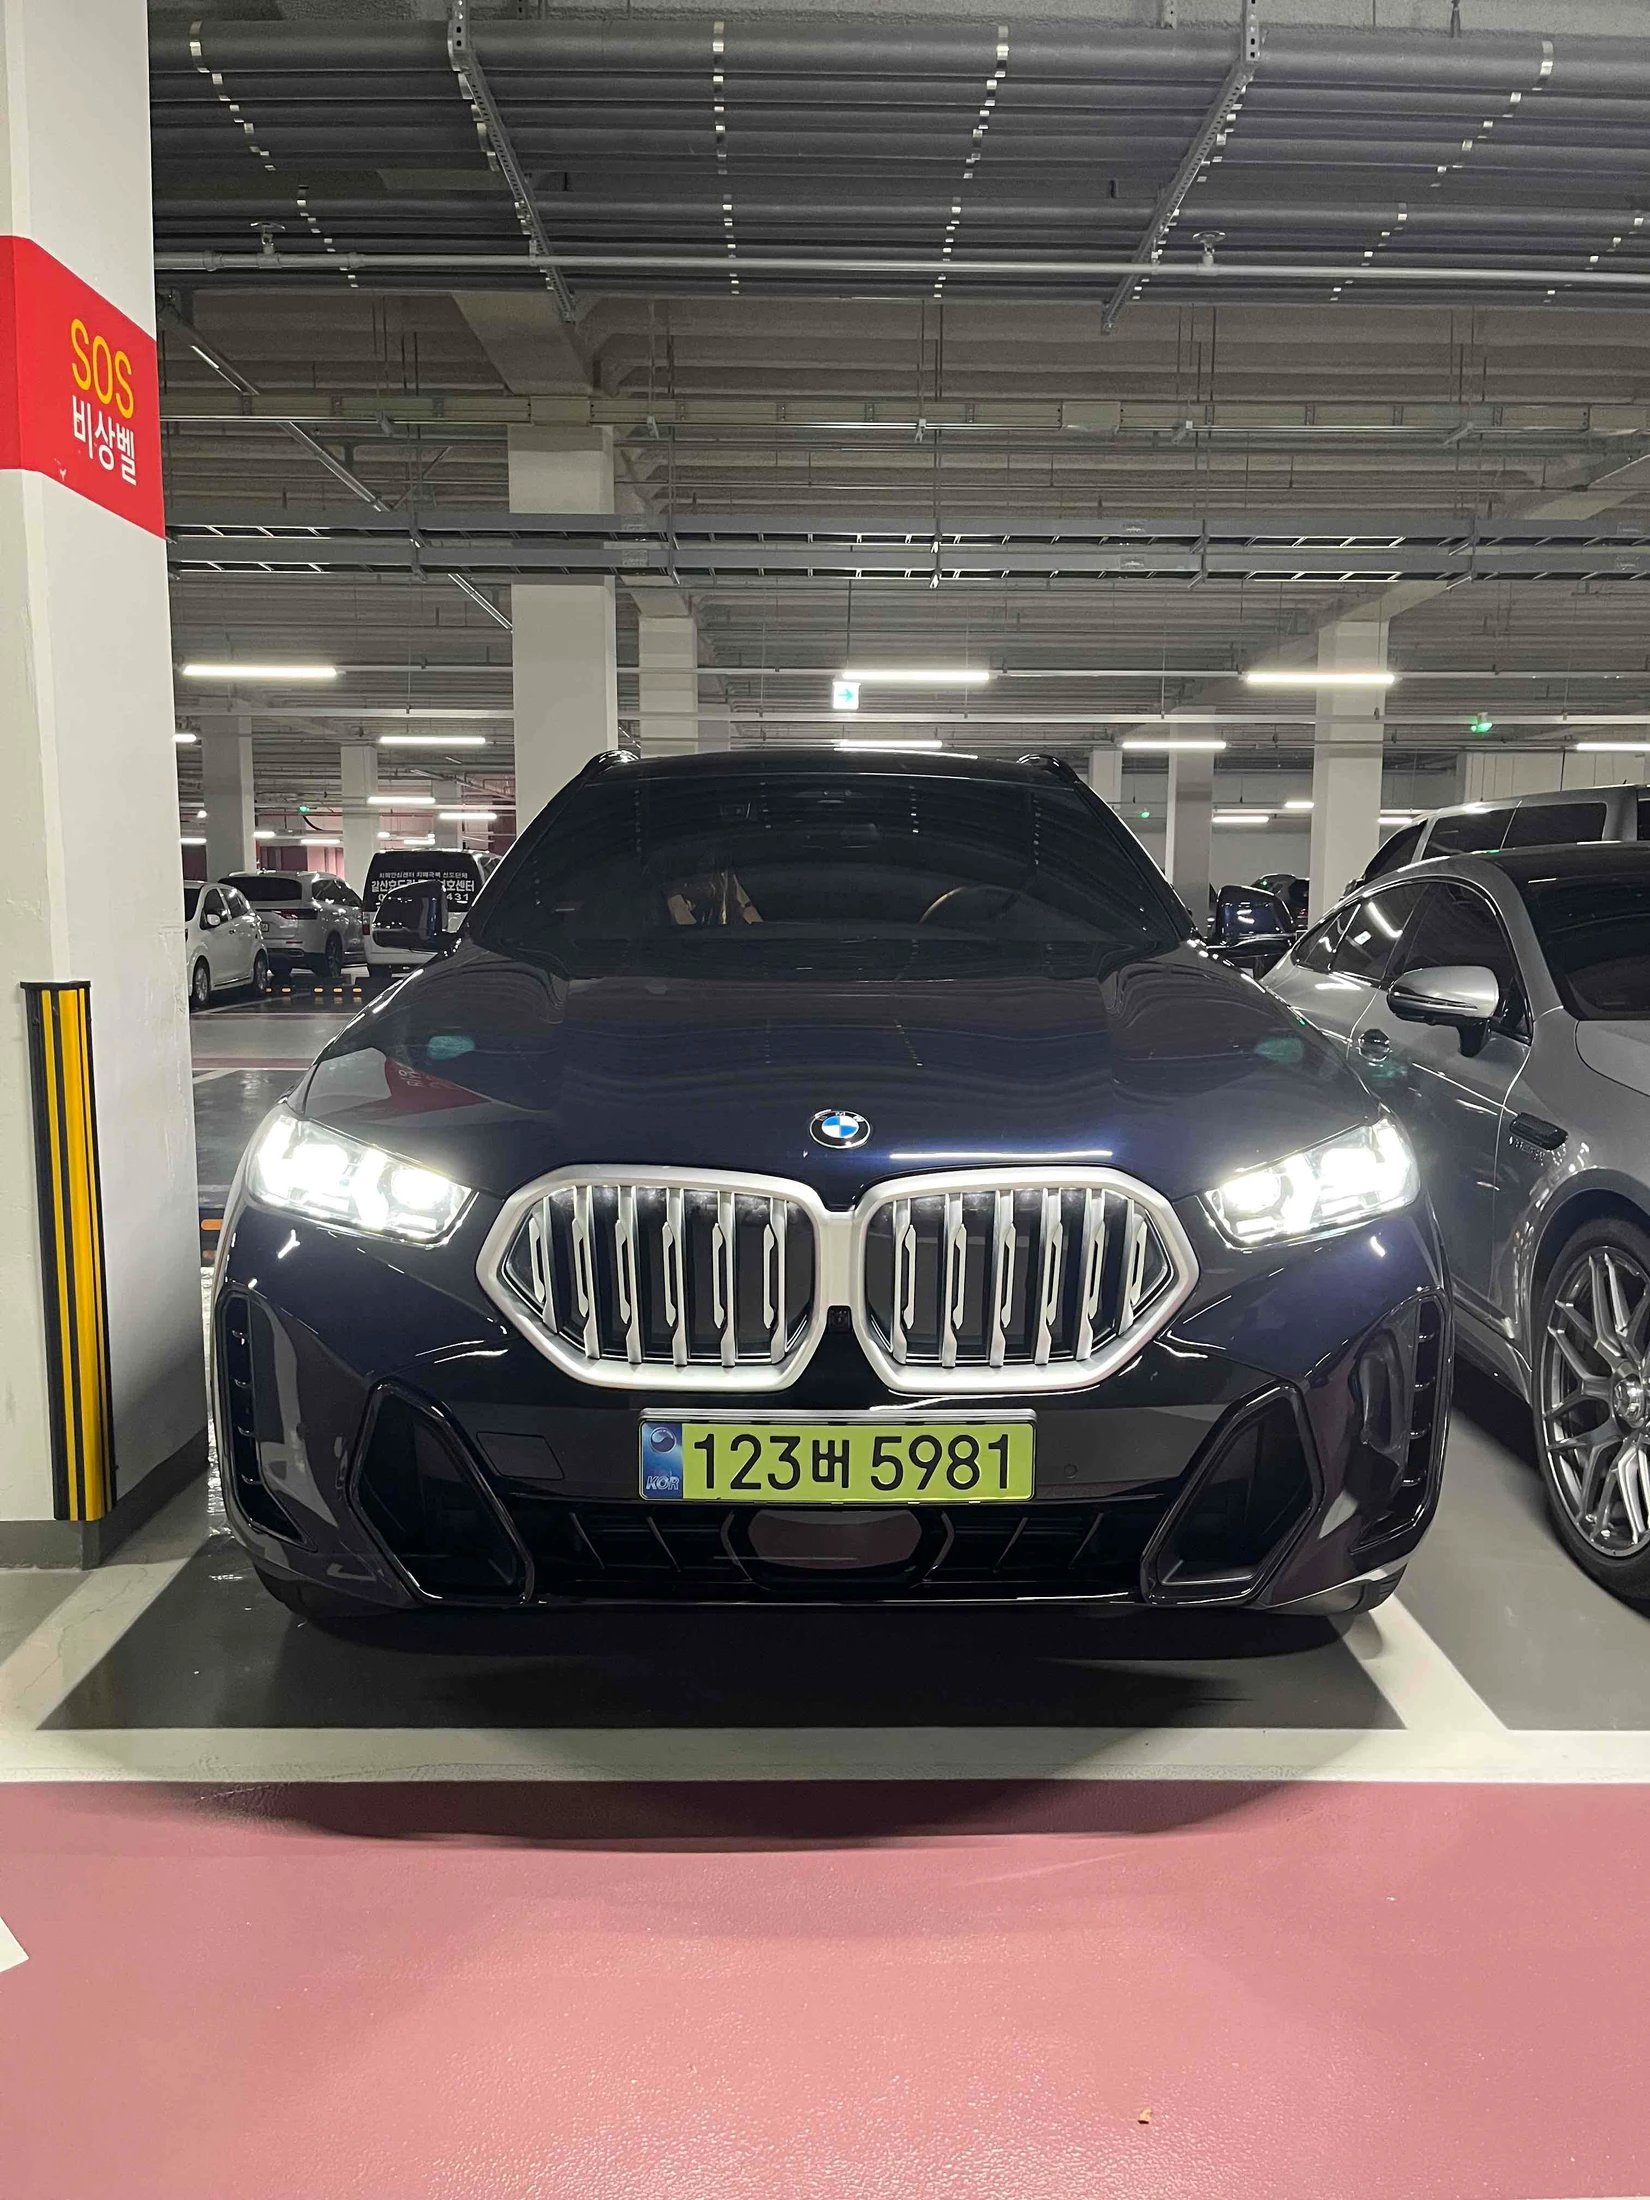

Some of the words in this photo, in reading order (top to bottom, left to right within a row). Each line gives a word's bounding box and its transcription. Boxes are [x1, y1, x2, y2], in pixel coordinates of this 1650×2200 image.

[71, 318, 134, 419] SOS
[72, 395, 137, 486] 비상벨
[645, 1474, 681, 1491] KOR
[694, 1433, 850, 1490] 123버
[870, 1433, 1010, 1491] 5981
